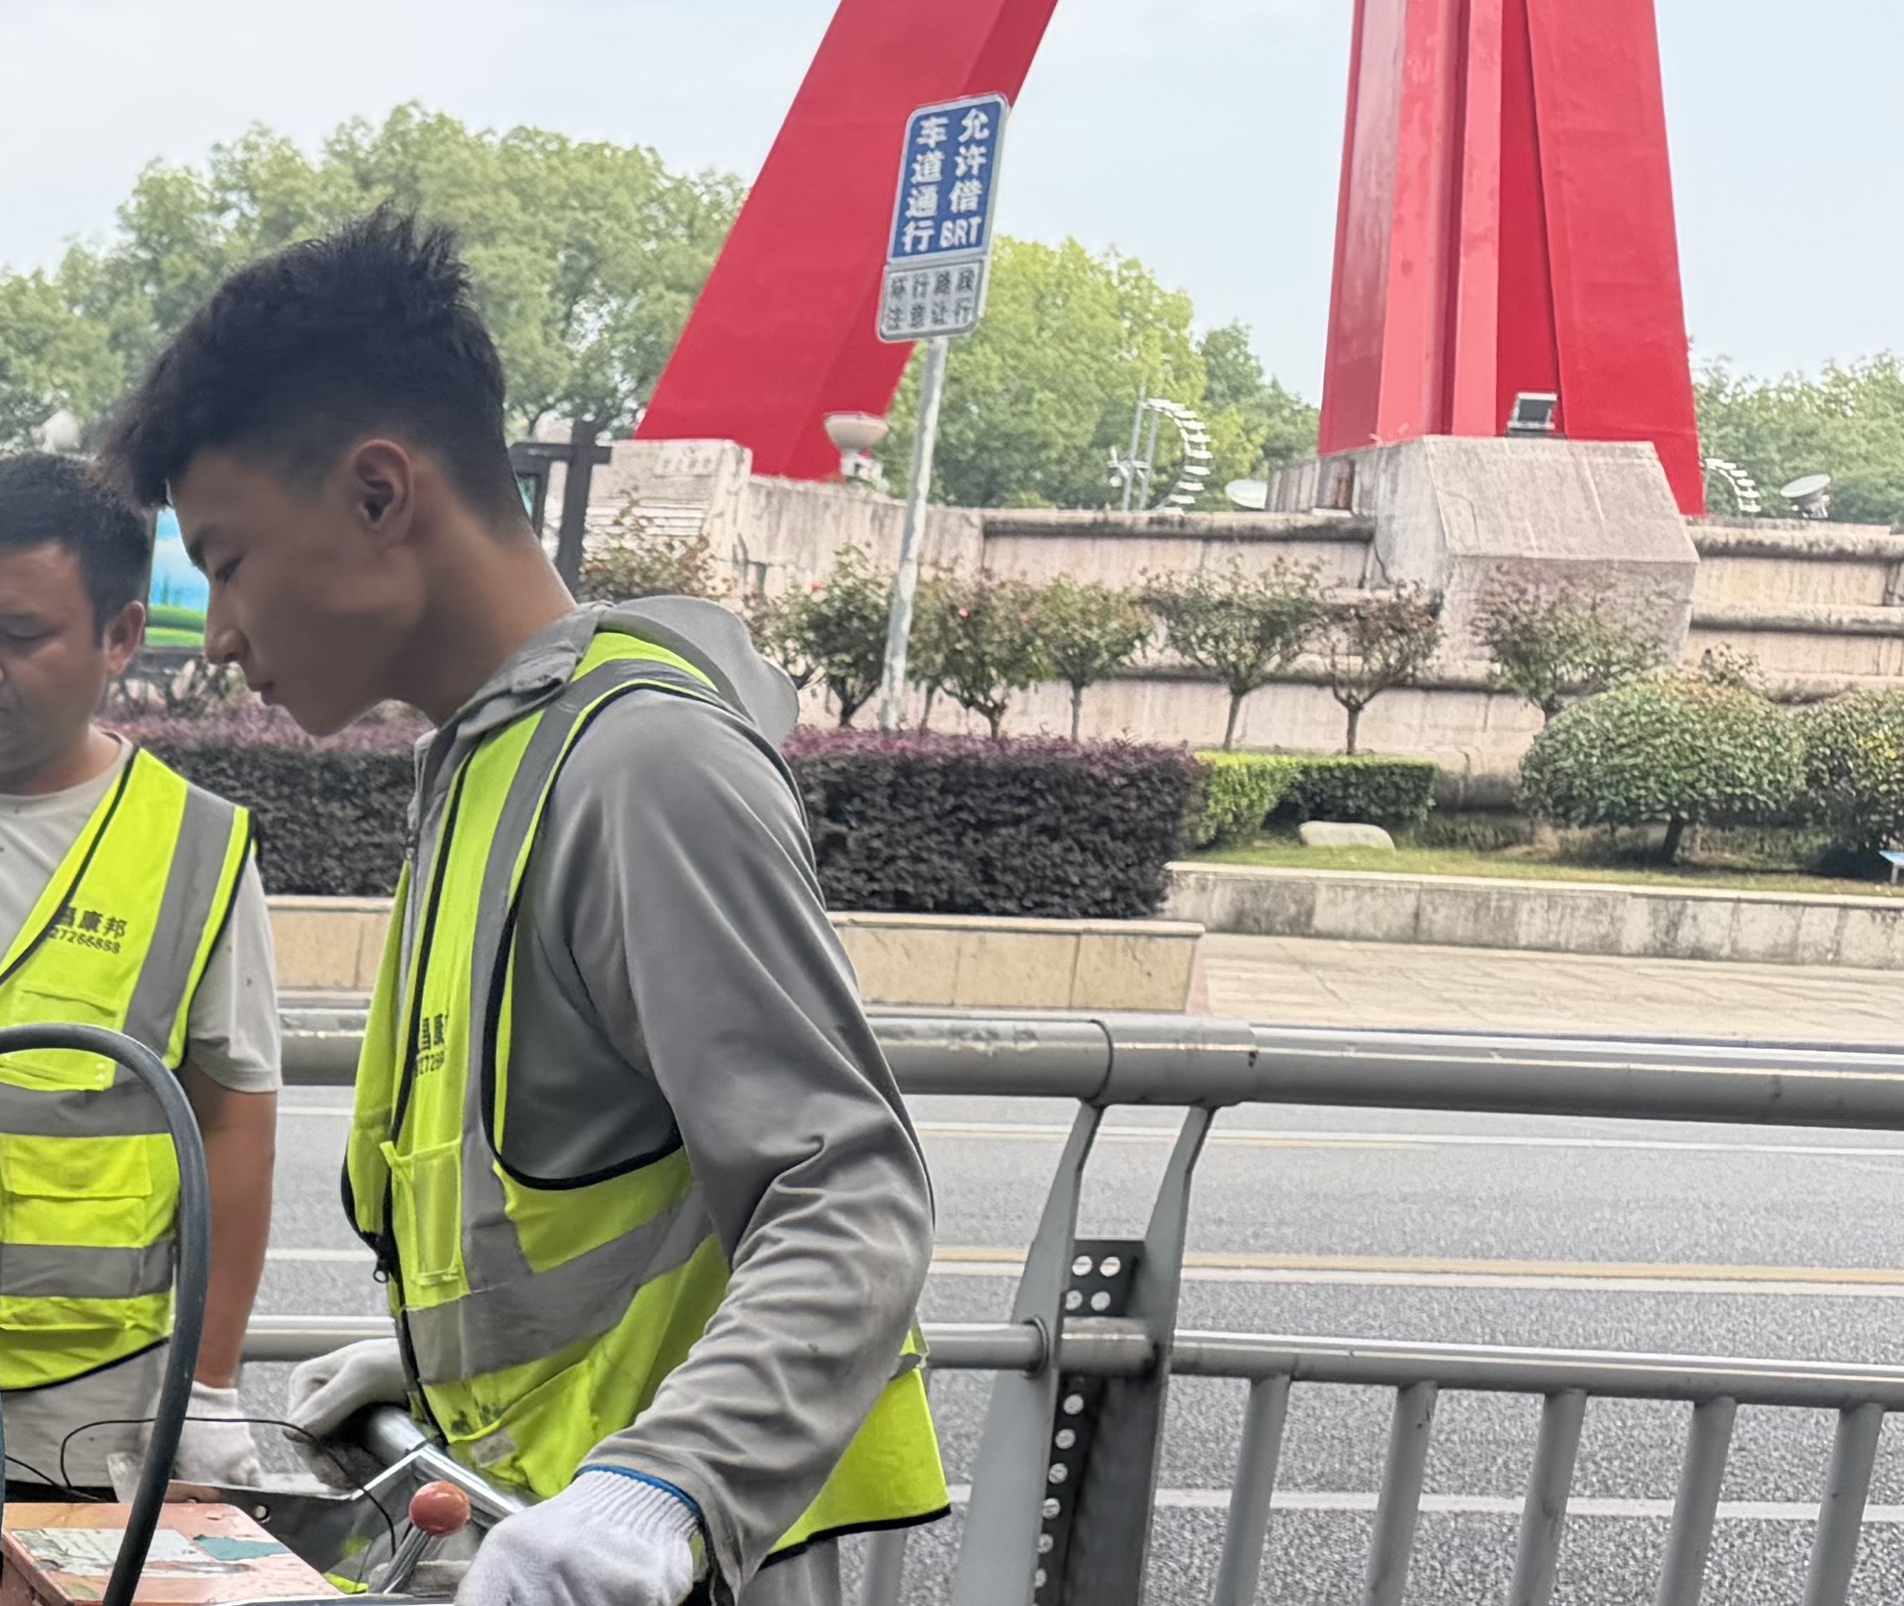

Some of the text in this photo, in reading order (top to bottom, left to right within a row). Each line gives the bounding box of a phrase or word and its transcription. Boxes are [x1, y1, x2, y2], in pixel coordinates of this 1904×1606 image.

[902, 116, 950, 252] 车道通行
[939, 107, 990, 248] 允许借BRT
